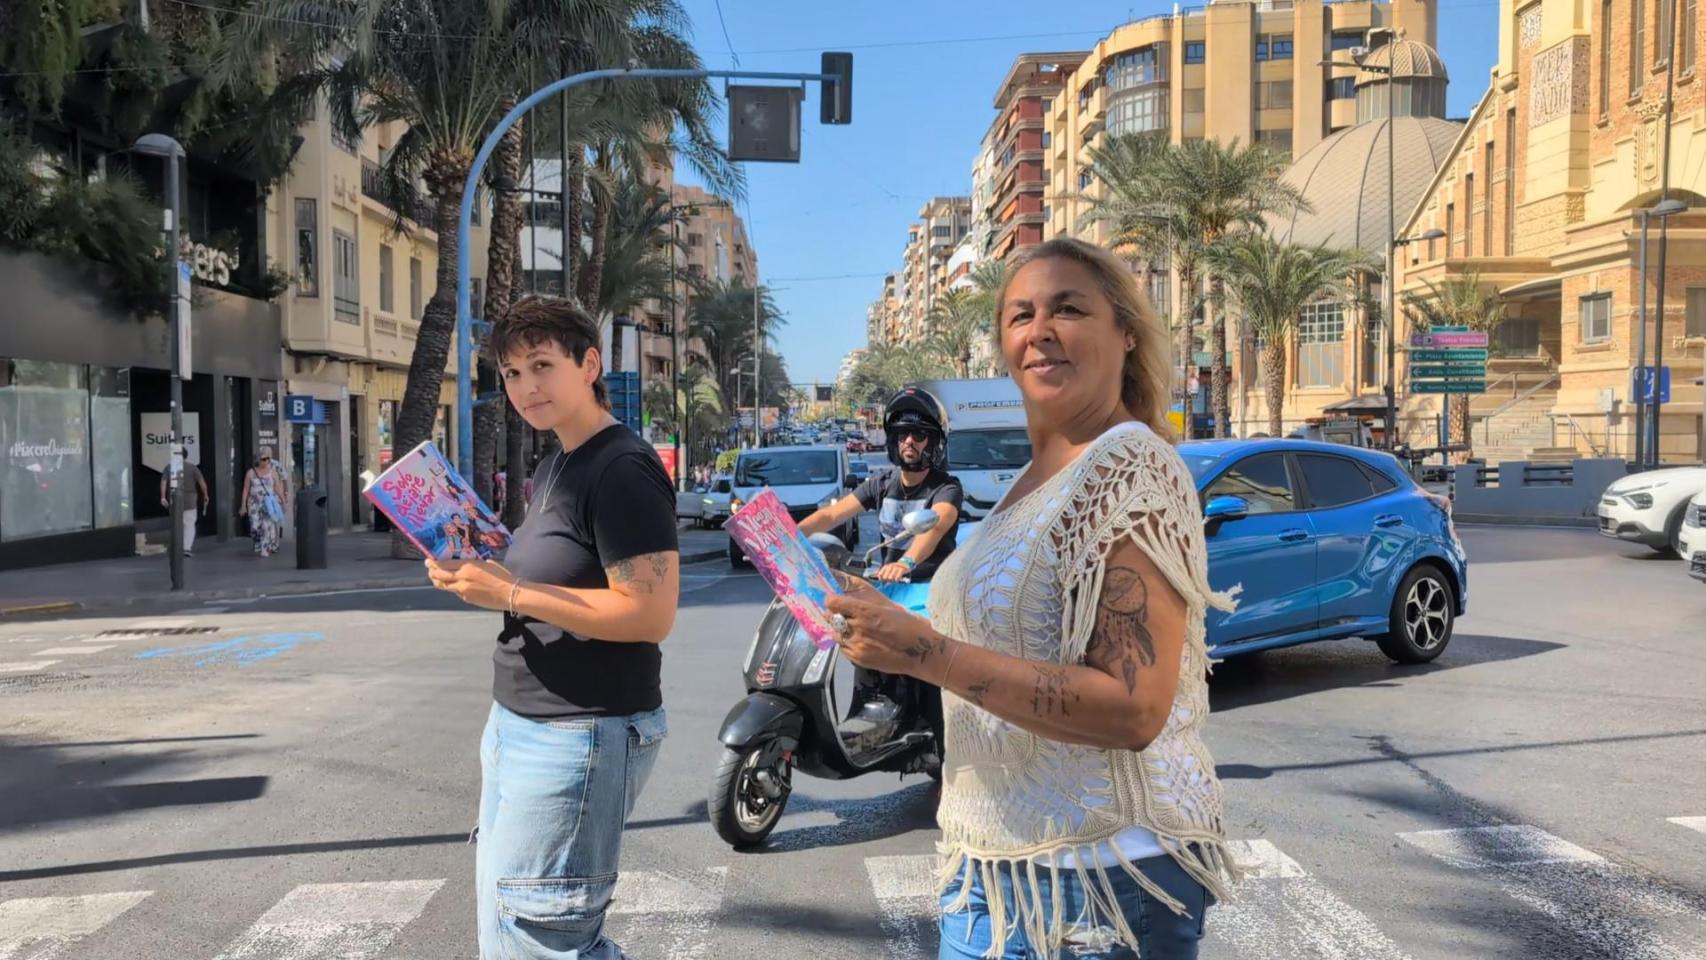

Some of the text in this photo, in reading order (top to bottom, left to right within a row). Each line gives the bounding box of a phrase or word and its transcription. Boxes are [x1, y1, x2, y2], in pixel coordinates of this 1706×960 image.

[293, 400, 305, 416] B
[146, 433, 194, 445] Suitrs
[383, 468, 412, 500] Solo
